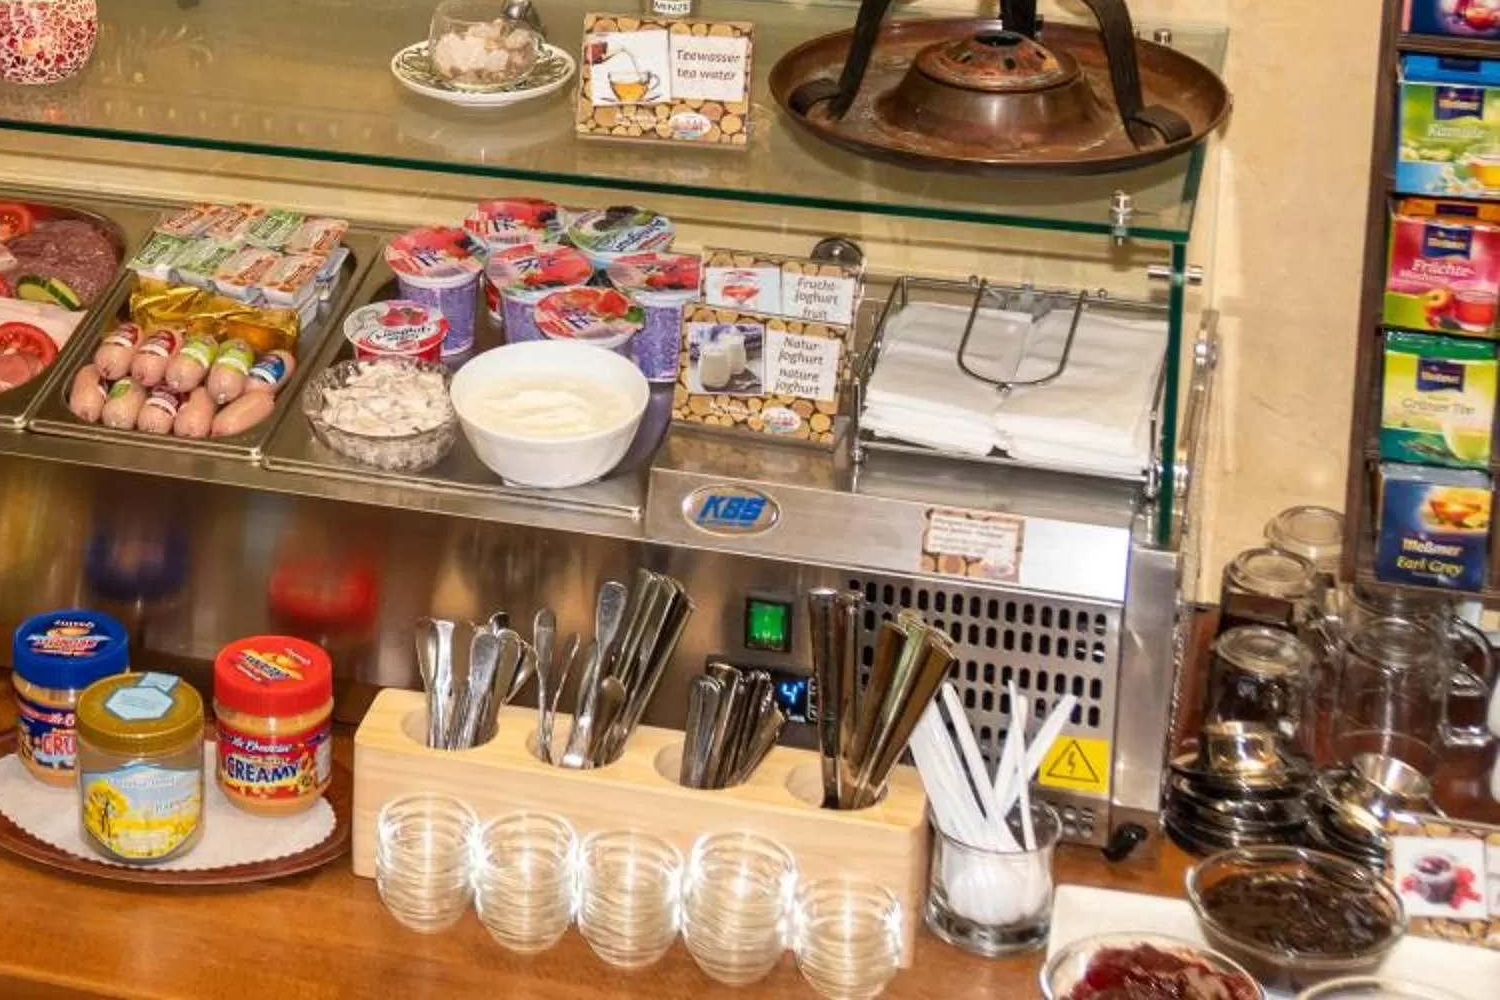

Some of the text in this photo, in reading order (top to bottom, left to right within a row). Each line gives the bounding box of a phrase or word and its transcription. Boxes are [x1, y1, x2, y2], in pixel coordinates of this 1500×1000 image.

[676, 49, 741, 63] Teewasser
[677, 68, 736, 80] tea water
[779, 367, 820, 381] nature
[698, 495, 767, 522] KBS
[1403, 537, 1463, 557] Meßmer
[1396, 555, 1465, 578] Earl Grey
[227, 756, 299, 784] CREAMY
